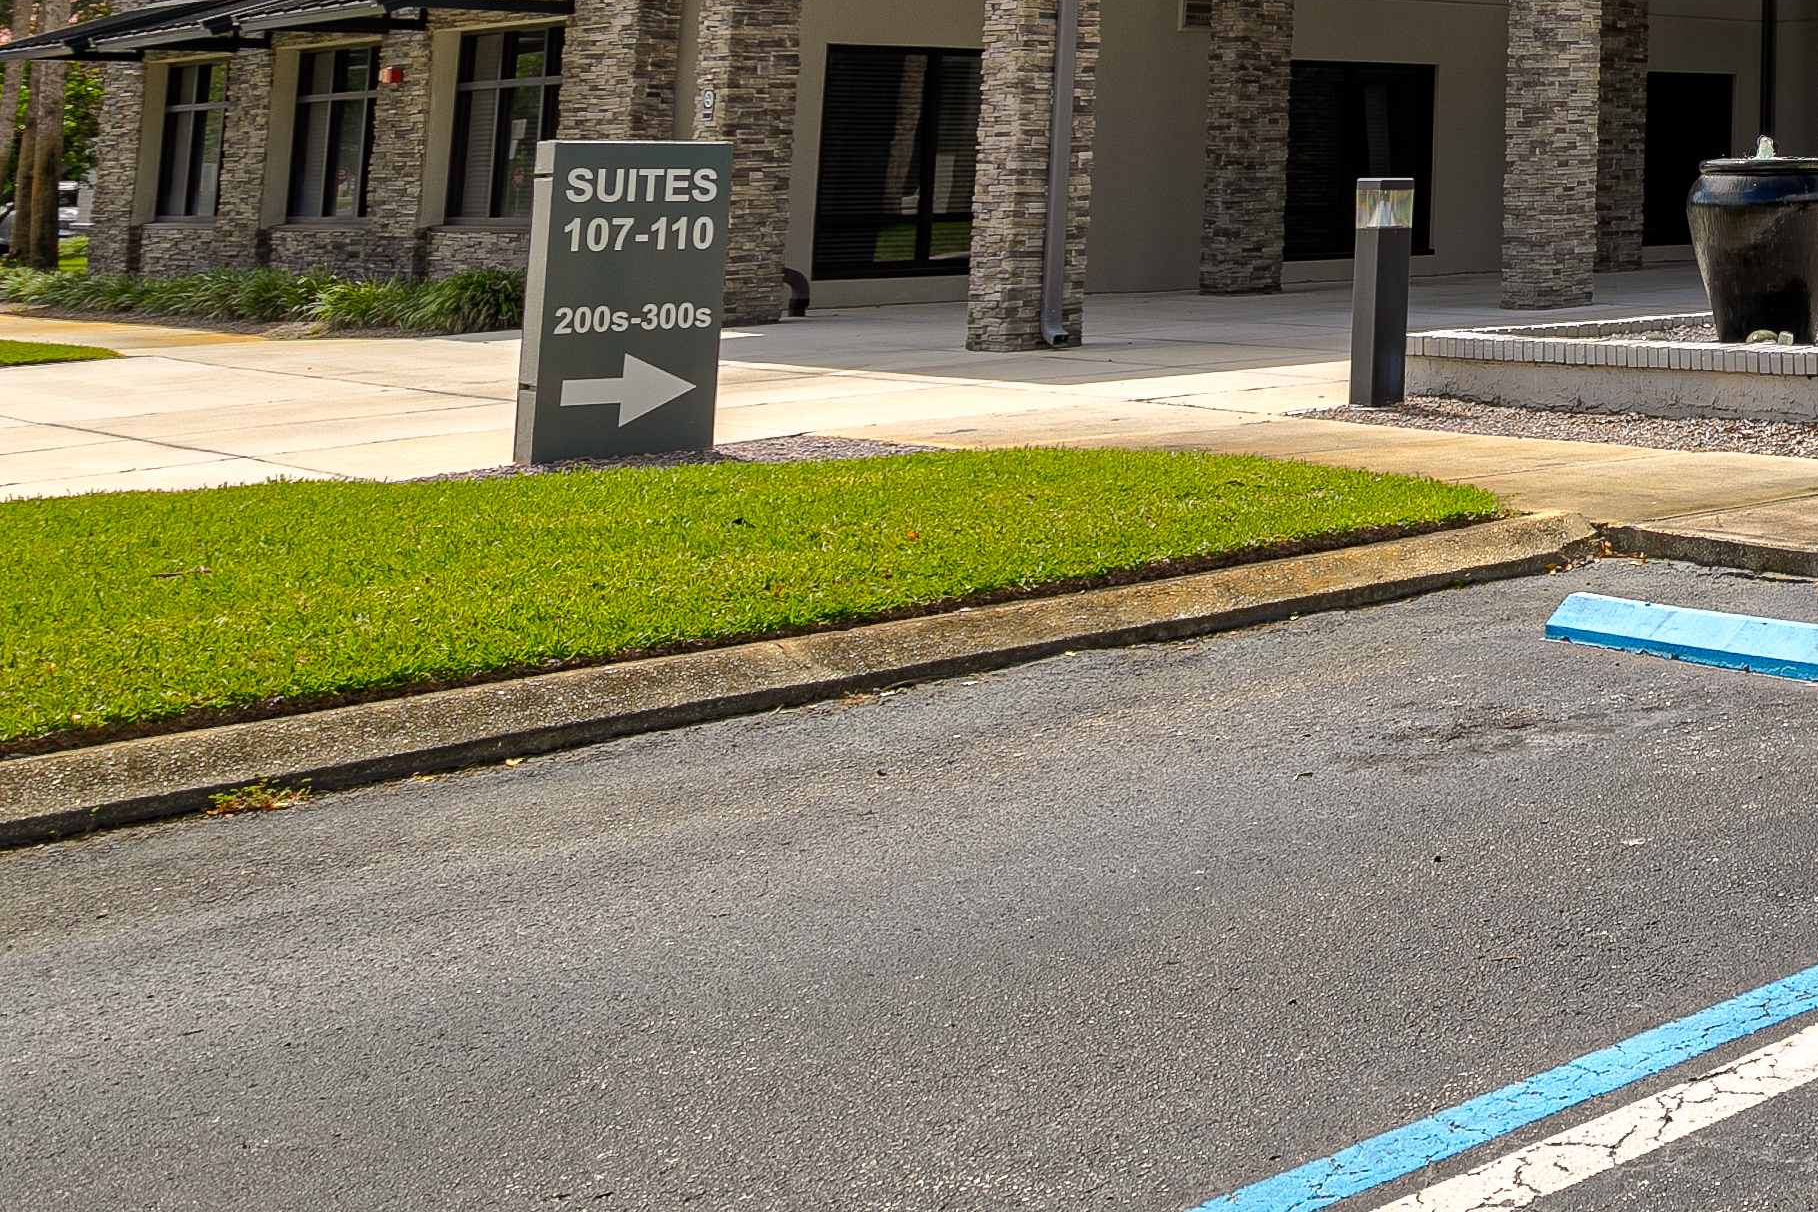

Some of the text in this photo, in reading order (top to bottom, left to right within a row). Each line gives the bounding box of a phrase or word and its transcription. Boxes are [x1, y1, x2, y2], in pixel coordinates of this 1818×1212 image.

[565, 167, 718, 203] SUITES
[564, 216, 714, 252] 107-110
[553, 302, 713, 335] 200s-300s
